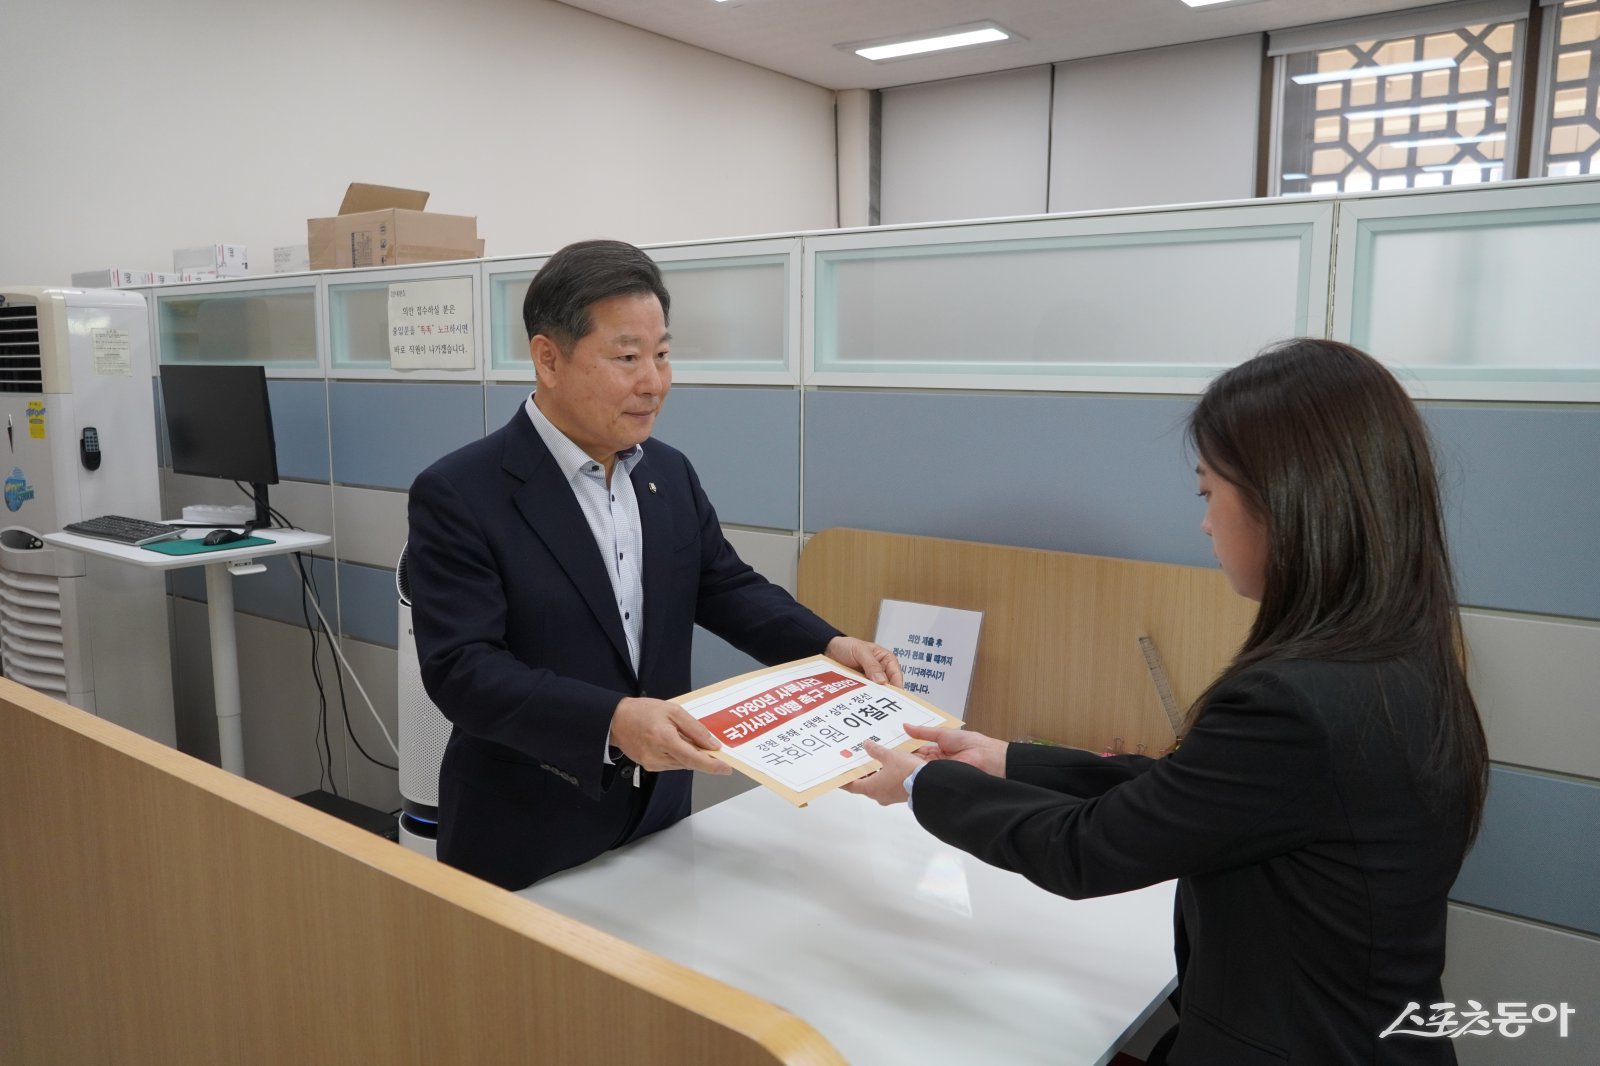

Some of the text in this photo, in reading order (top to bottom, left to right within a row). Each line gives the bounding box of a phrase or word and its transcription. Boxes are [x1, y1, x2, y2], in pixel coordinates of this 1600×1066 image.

[416, 304, 440, 315] 접수하실
[443, 304, 456, 315] 분은
[437, 323, 469, 334] 노크하시면
[394, 343, 468, 355] 바로 직원이 나가겠습니다.
[907, 634, 943, 648] 의안 제출 후
[912, 650, 924, 661] 완료
[933, 653, 954, 666] 때까지
[908, 665, 945, 681] 기다려주시기
[904, 681, 930, 695] 바랍니다.
[722, 678, 859, 741] 국가사과 이행 촉구 결의안
[729, 695, 779, 719] 1980년
[761, 696, 904, 766] 국회의원 이철규
[755, 738, 780, 752] 강원
